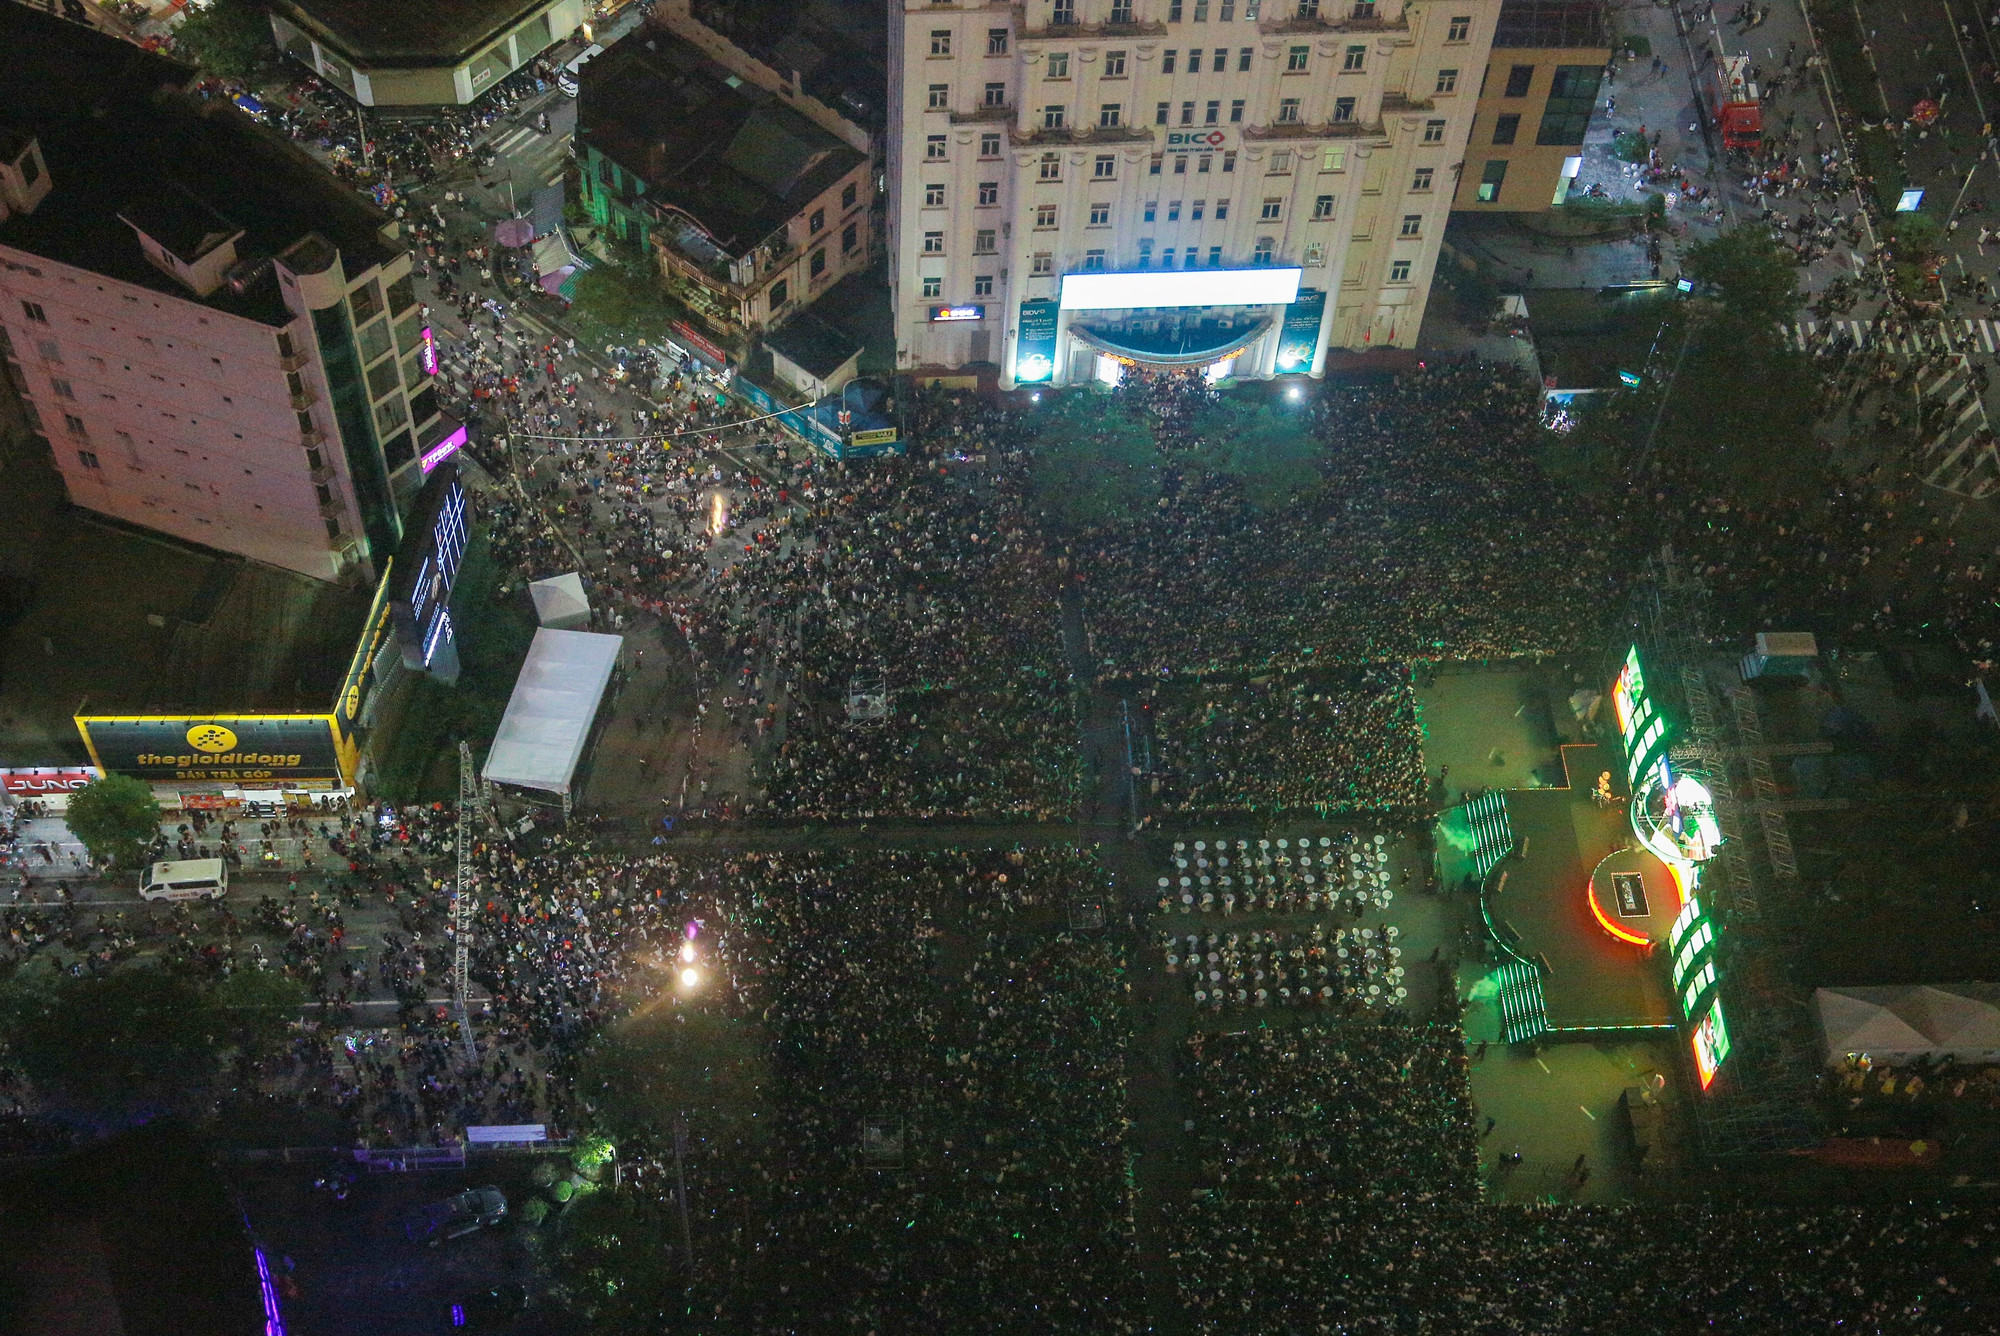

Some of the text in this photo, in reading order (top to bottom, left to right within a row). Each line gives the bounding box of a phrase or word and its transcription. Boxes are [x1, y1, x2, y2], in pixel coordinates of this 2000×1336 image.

[1168, 133, 1206, 144] BIC
[428, 441, 454, 462] TPBank
[137, 753, 301, 767] thegioididong
[176, 771, 206, 779] BÁN
[243, 769, 272, 779] GÓP
[8, 780, 88, 790] JUNO
